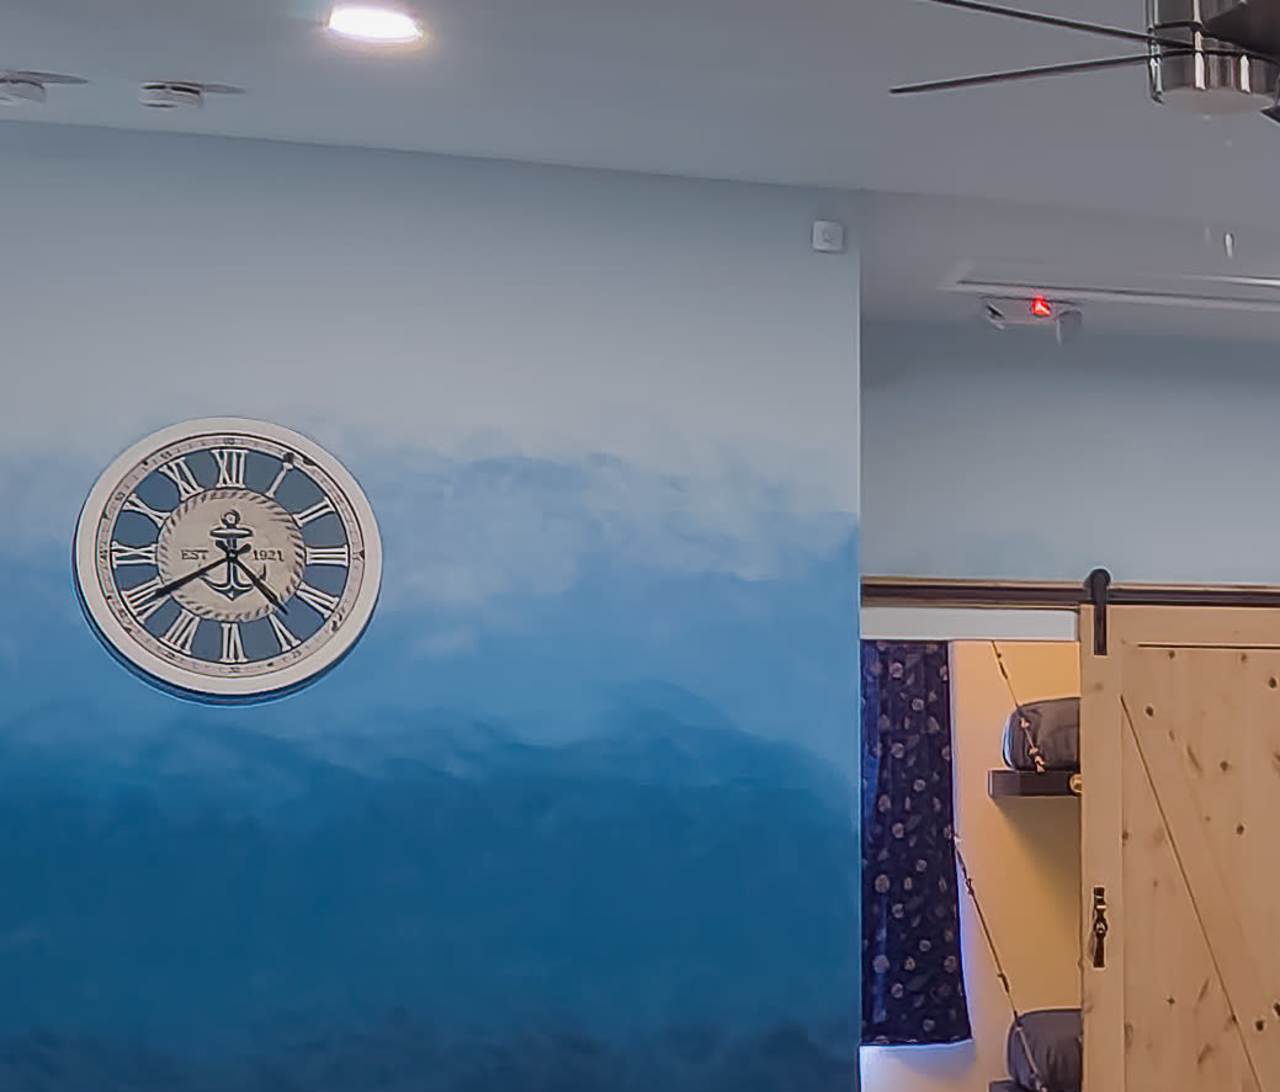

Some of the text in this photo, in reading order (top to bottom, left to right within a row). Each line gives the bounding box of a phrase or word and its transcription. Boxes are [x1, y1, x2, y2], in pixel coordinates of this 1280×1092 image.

[210, 449, 249, 489] XII
[181, 549, 284, 562] EST 1921
